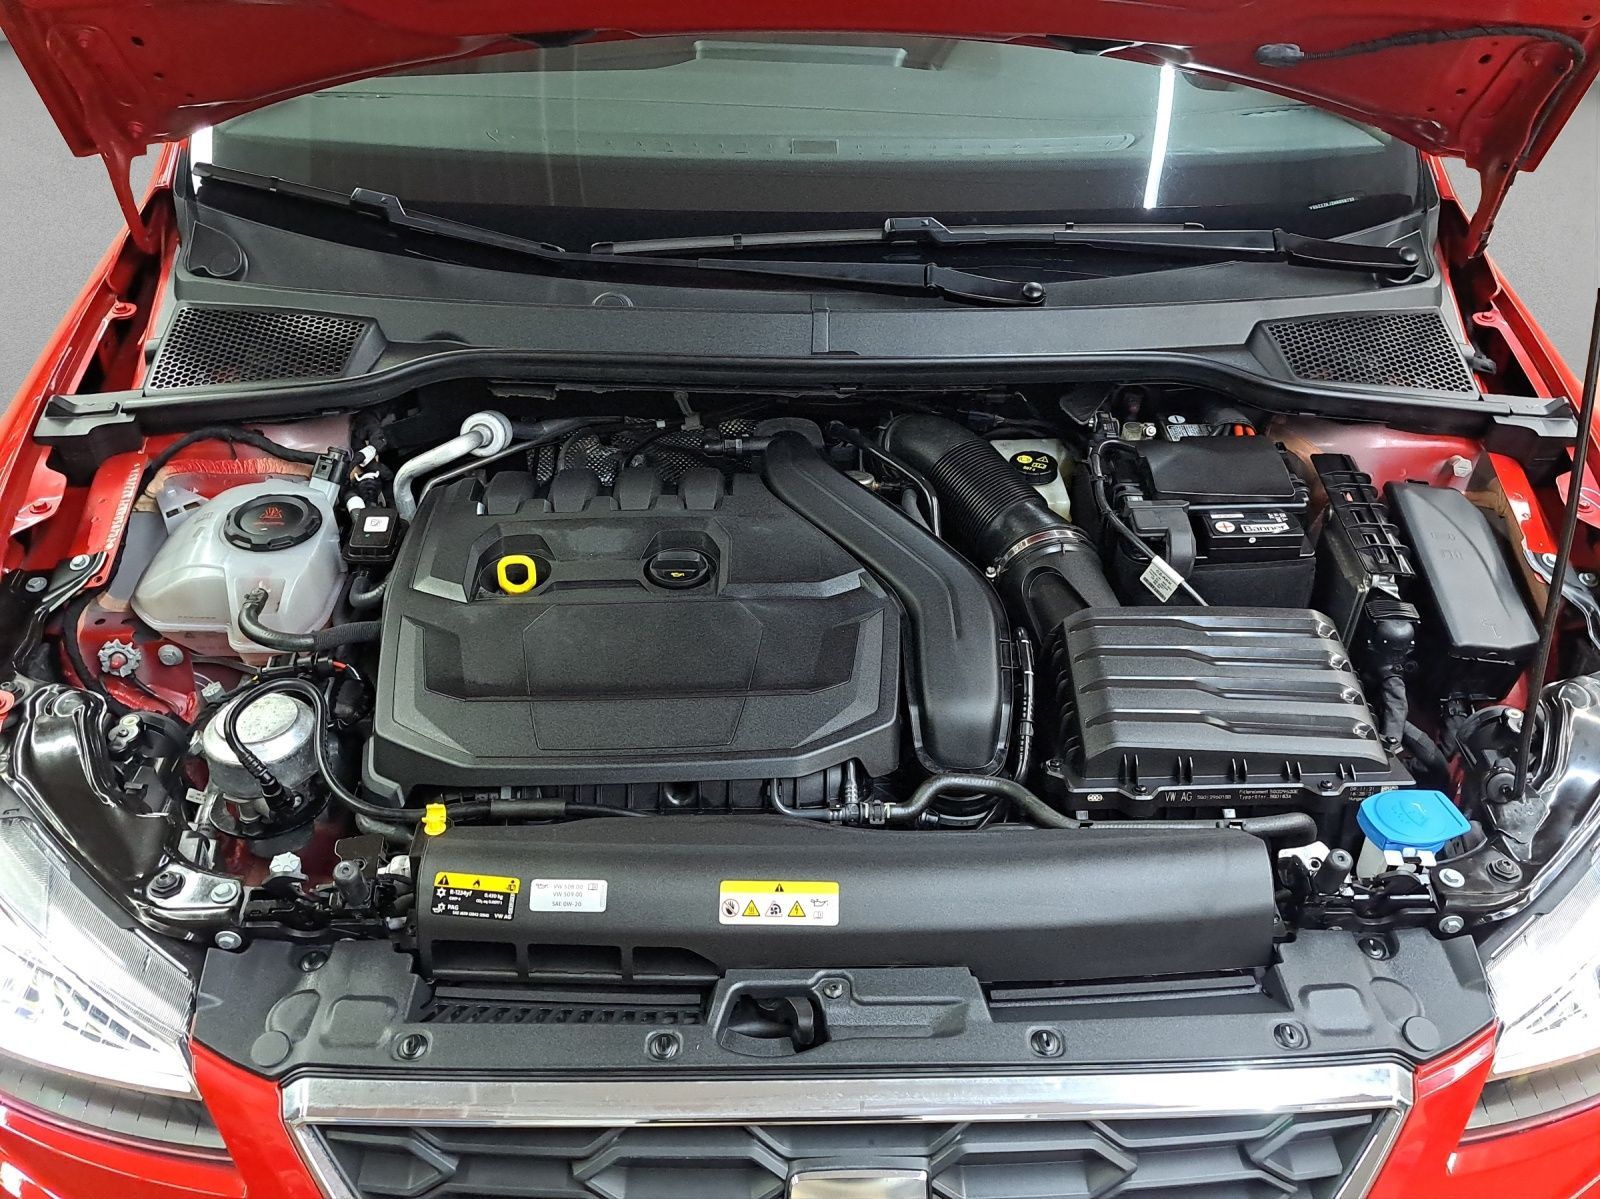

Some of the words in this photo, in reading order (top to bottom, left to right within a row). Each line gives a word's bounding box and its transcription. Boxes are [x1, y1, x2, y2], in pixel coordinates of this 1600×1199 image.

[1165, 792, 1176, 802] VW
[1180, 792, 1192, 802] AG
[449, 889, 473, 898] R-1234yf
